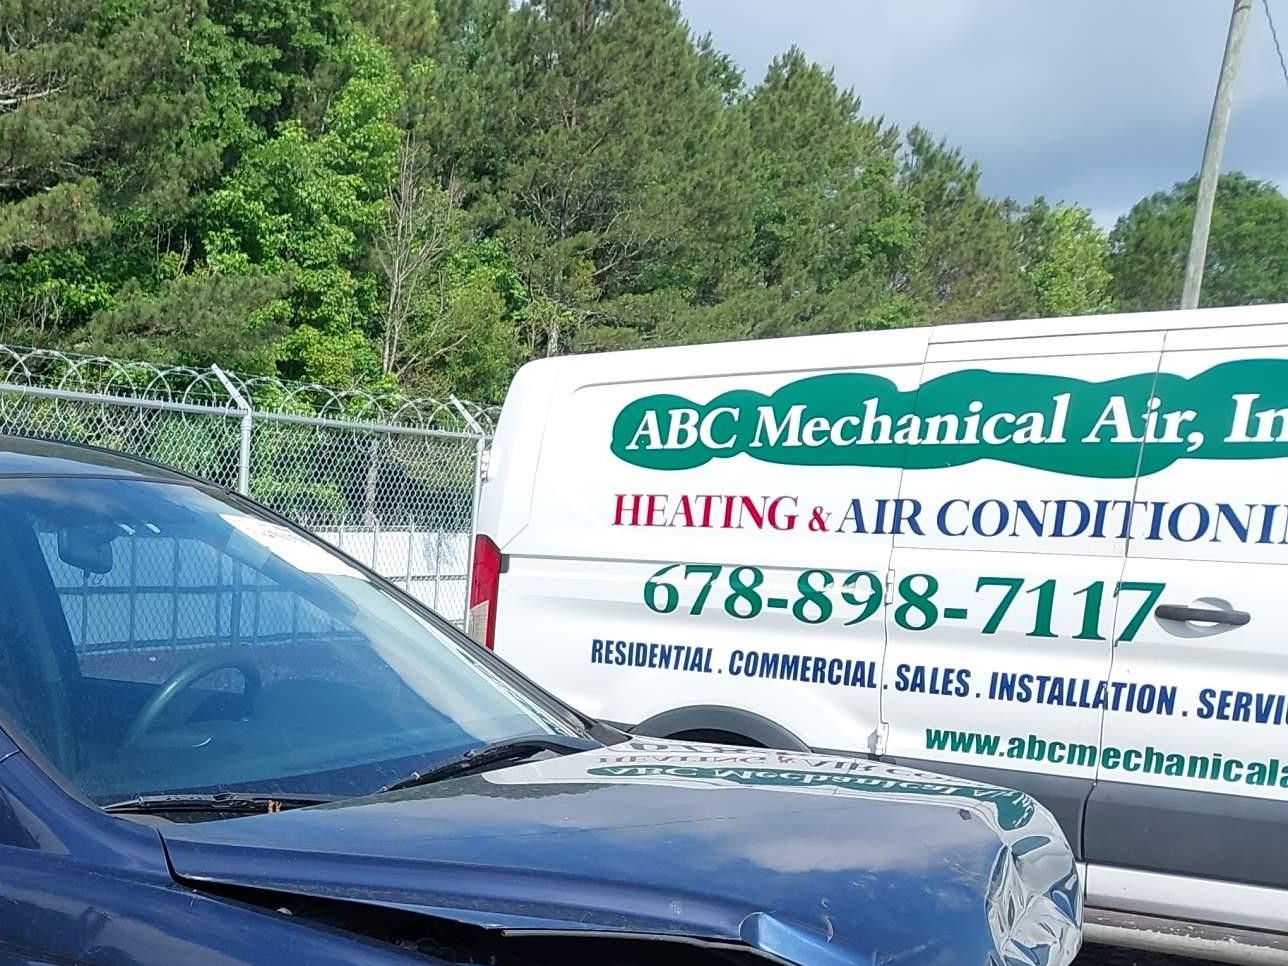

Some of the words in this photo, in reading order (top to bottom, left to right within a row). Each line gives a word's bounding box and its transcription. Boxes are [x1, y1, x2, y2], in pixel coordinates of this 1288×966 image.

[625, 407, 741, 450] ABC
[749, 393, 1071, 448] Mechanical
[1081, 396, 1205, 452] Air,
[612, 493, 799, 531] HEATING
[808, 505, 831, 532] &
[835, 498, 926, 536] AIR
[937, 499, 1288, 544] CONDITIONI
[643, 563, 1166, 642] 678-898-7117
[591, 639, 713, 673] RESIDENTIAL
[729, 650, 877, 689] COMMERCIAL
[895, 663, 971, 698] SALES
[989, 672, 1177, 716] INSTALLATION
[1197, 688, 1288, 725] SERVI
